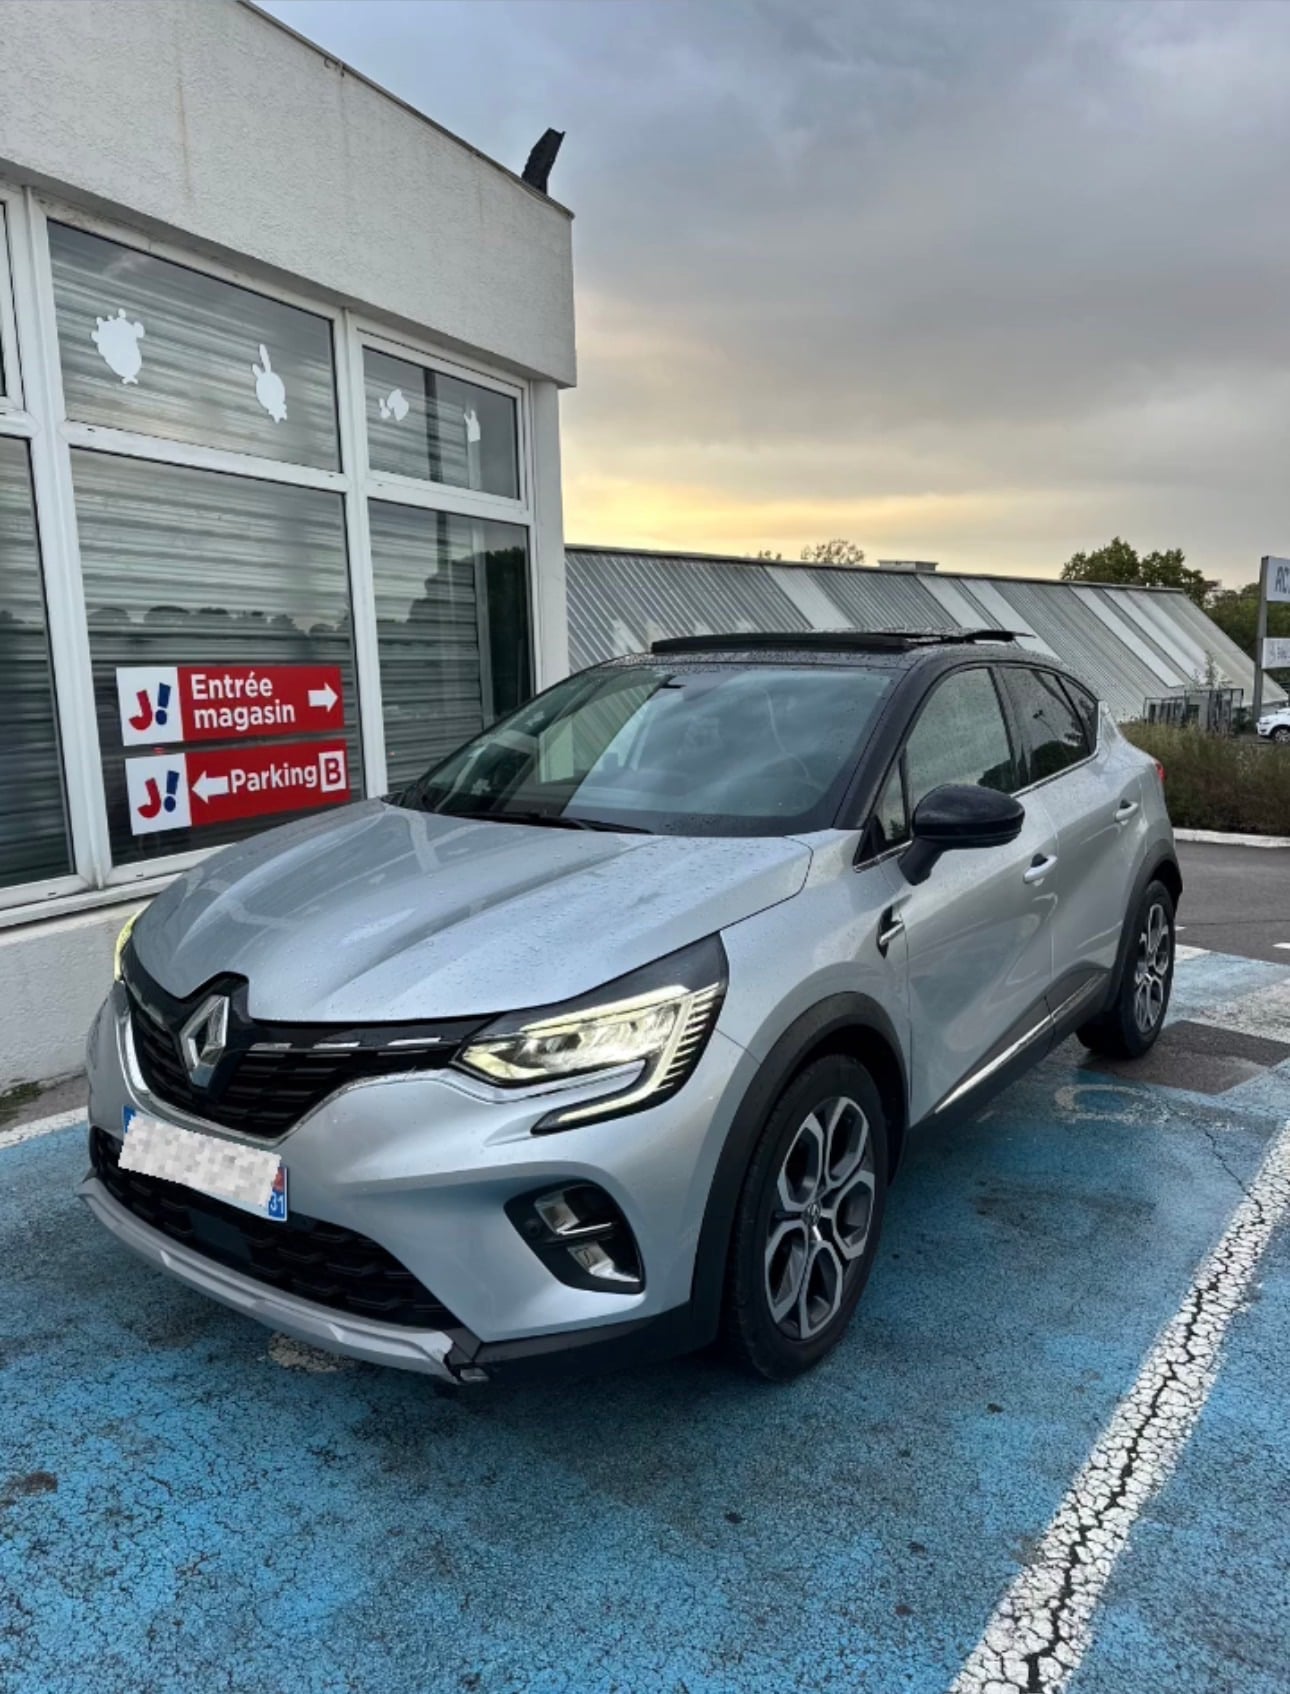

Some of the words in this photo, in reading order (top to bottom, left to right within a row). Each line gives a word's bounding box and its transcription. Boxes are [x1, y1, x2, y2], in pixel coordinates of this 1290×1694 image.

[190, 671, 273, 700] Entrée
[193, 699, 296, 731] magasin
[230, 763, 318, 793] Parking
[324, 757, 342, 786] B
